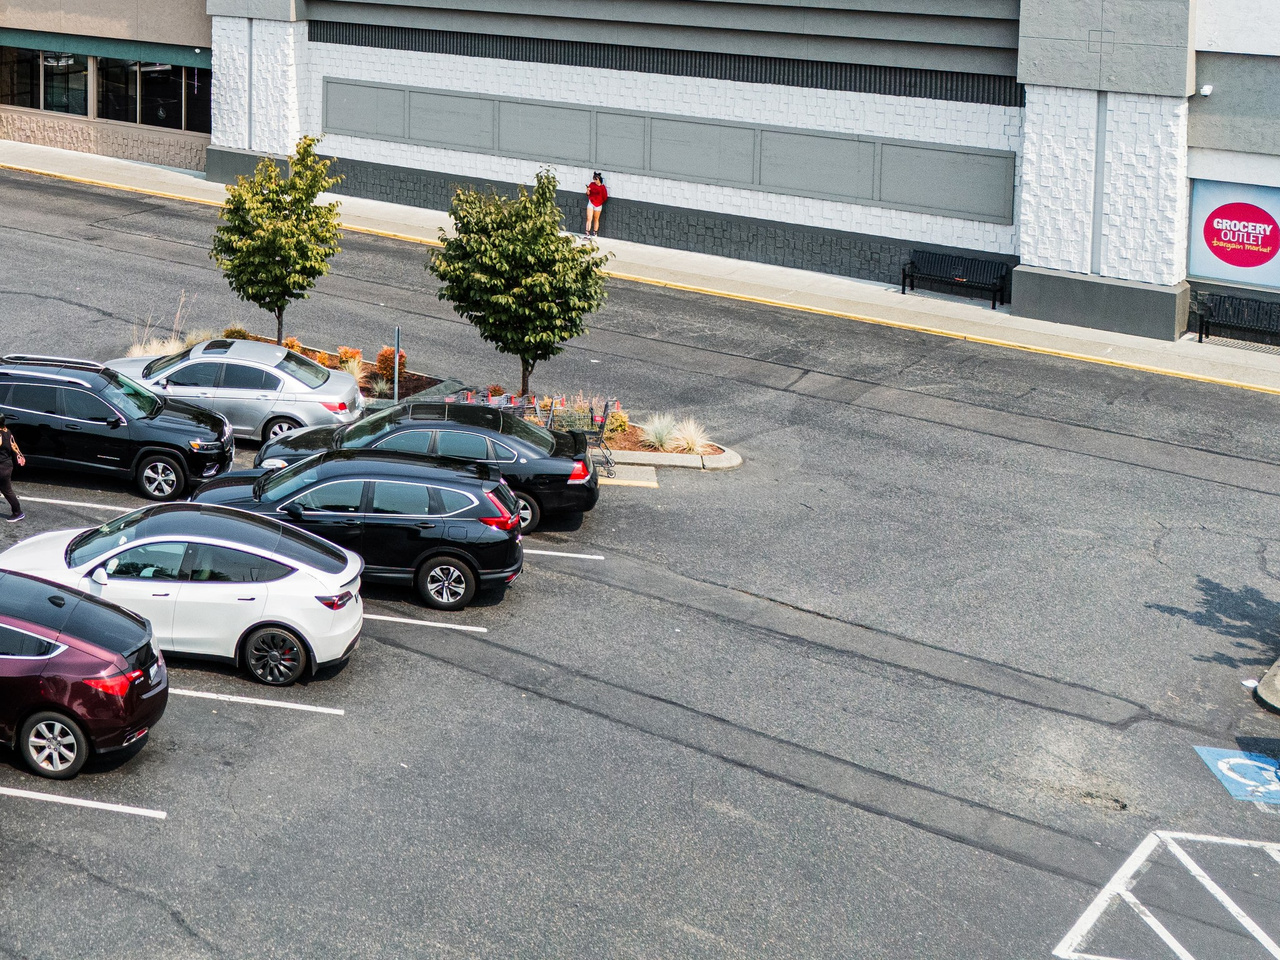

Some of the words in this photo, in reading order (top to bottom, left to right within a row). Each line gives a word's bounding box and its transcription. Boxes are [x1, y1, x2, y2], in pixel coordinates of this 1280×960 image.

[1213, 218, 1273, 235] GROCERY
[1212, 237, 1243, 252] bargain
[1245, 243, 1272, 253] market
[1221, 230, 1264, 245] OUTLET
